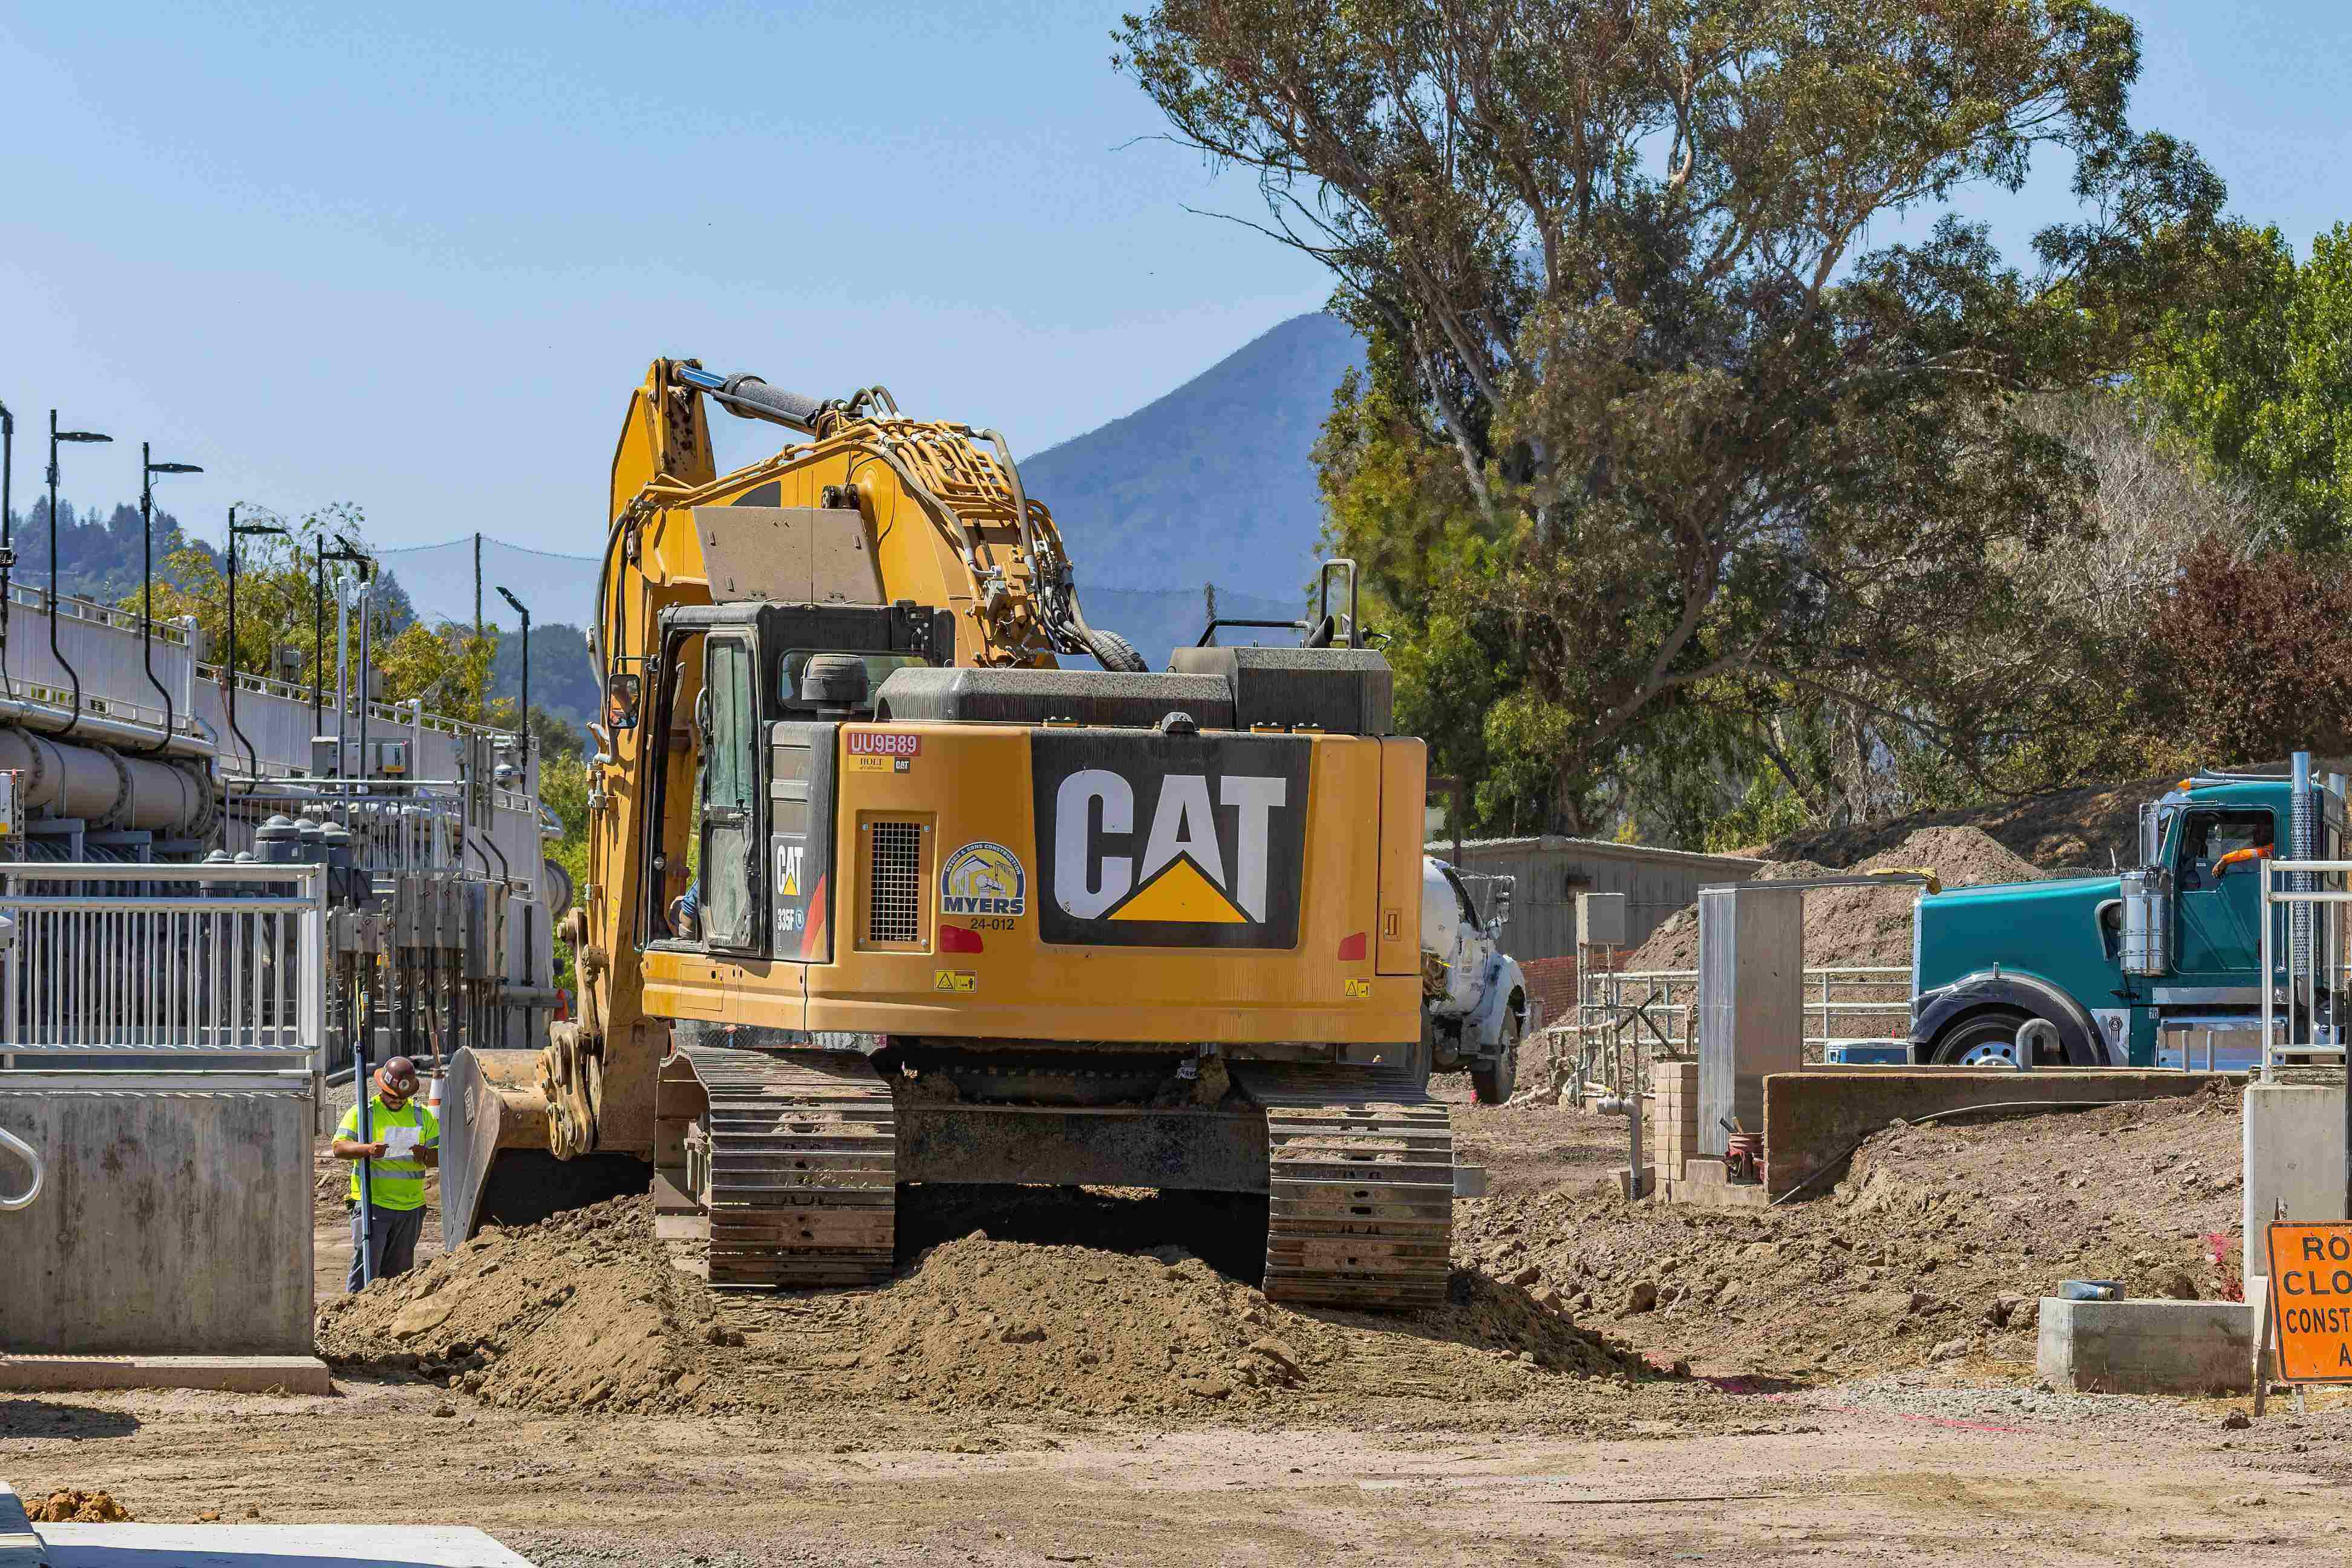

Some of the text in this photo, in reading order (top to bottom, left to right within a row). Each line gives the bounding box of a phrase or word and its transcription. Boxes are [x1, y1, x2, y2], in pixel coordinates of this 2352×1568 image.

[851, 734, 916, 753] UU9B89
[896, 760, 909, 769] CAT
[1054, 769, 1287, 924] CAT
[777, 844, 804, 896] CAT
[944, 897, 1024, 913] MYERS
[971, 919, 1014, 930] 24-012
[2302, 1236, 2350, 1261] RO
[2284, 1270, 2352, 1295] CLO
[2286, 1308, 2350, 1334] CONST
